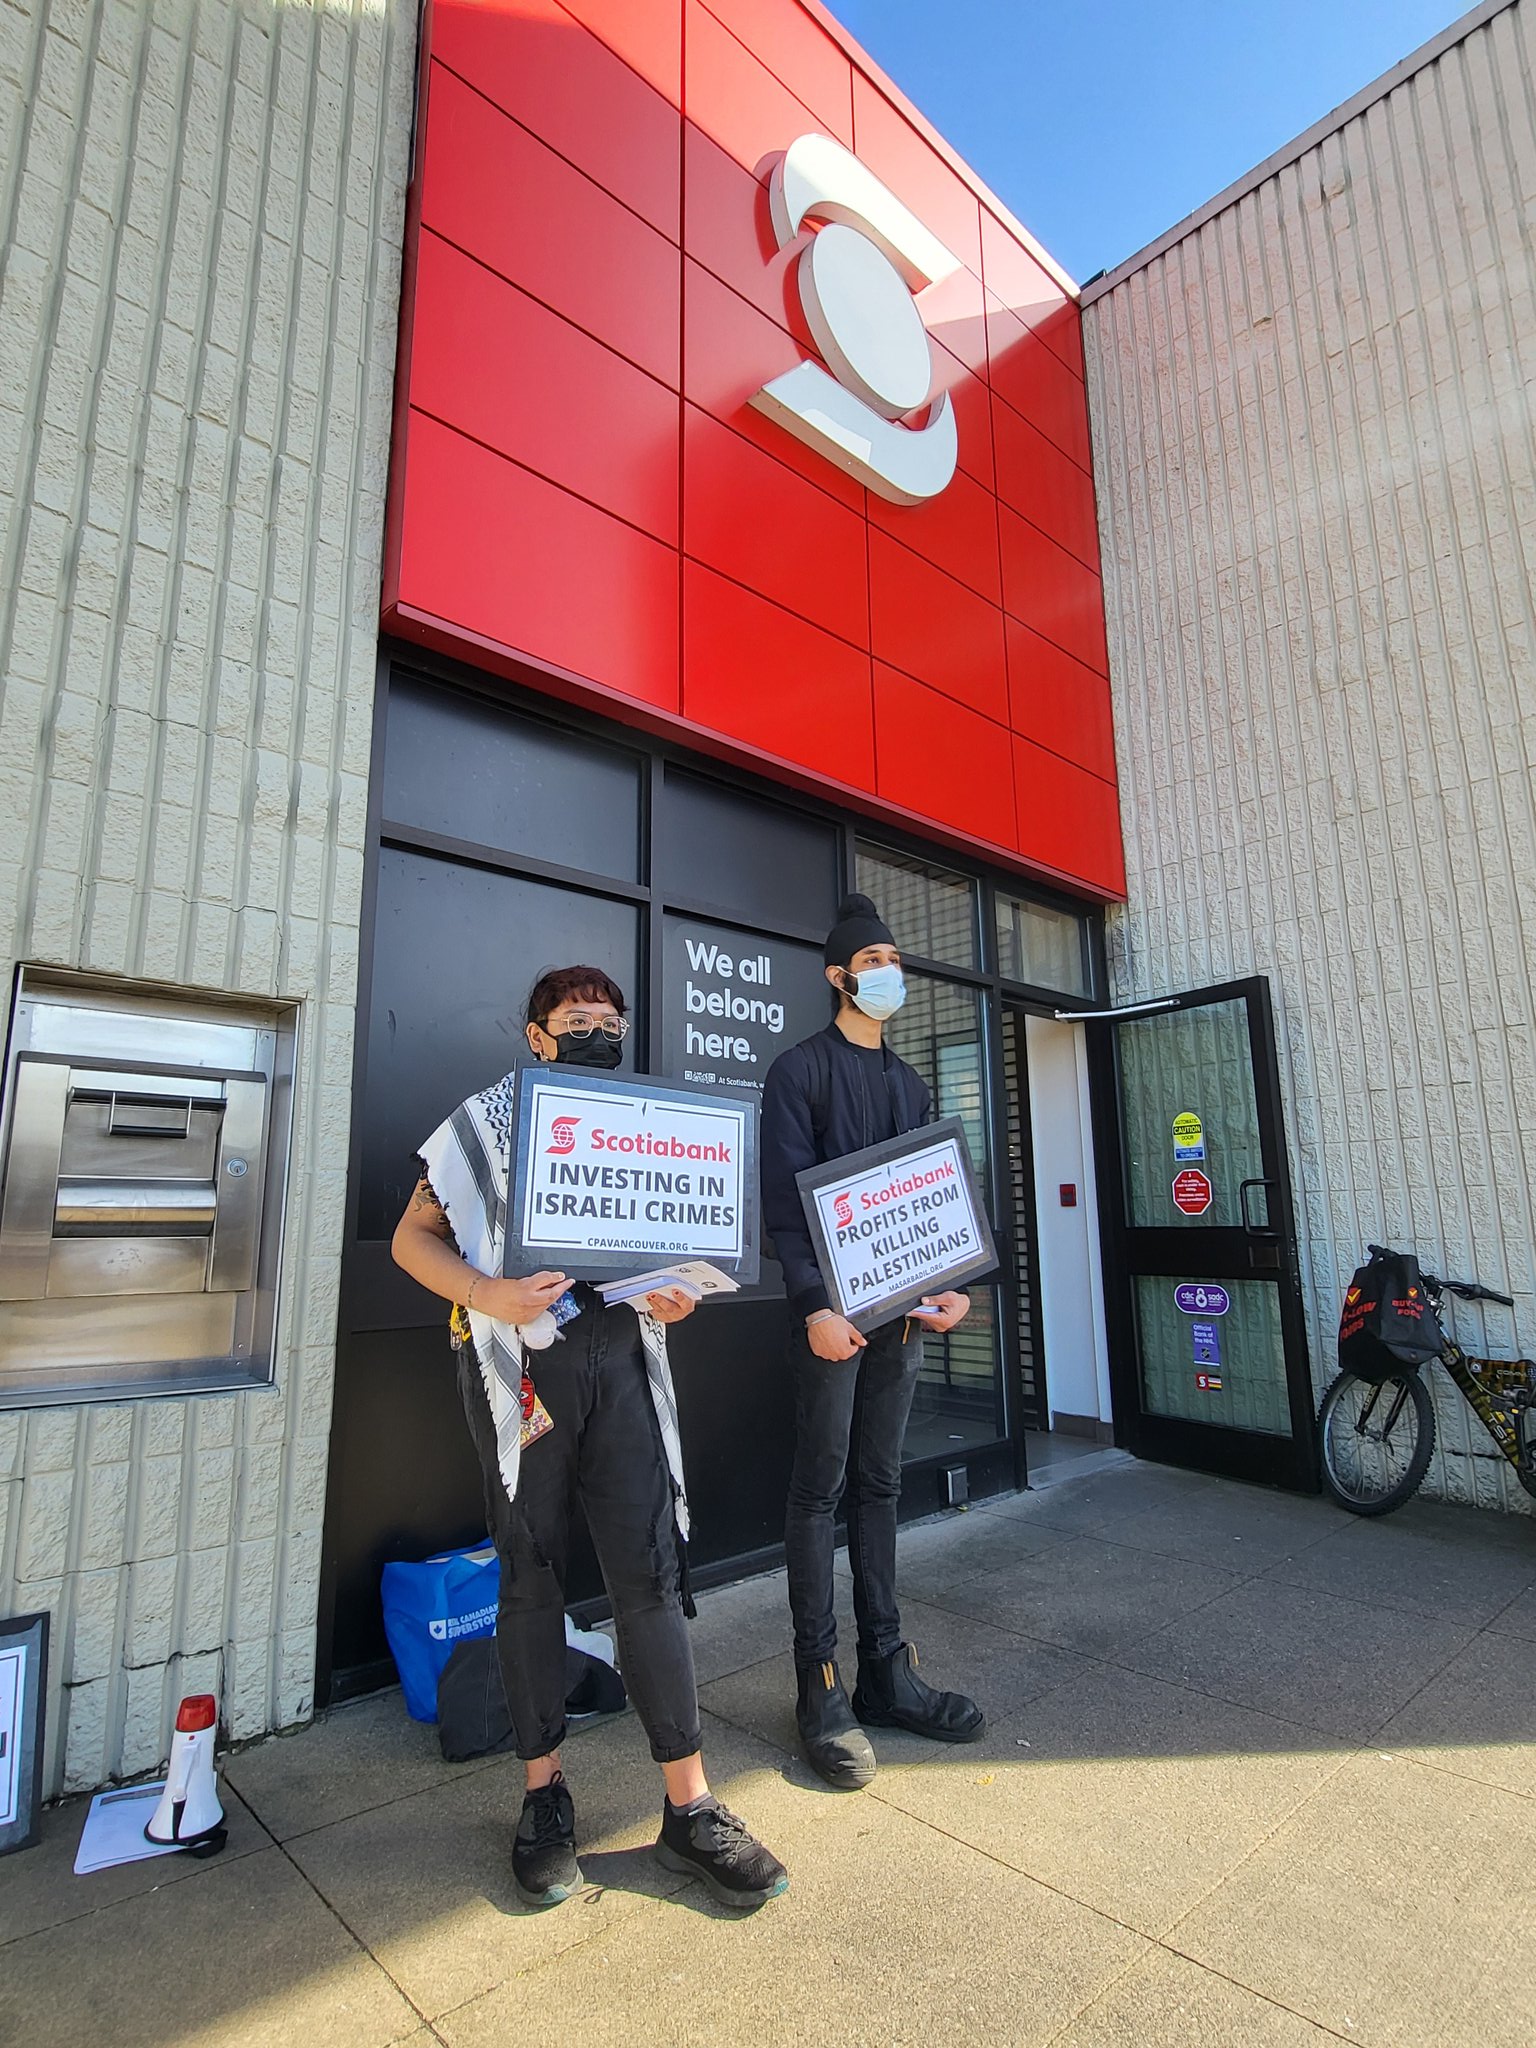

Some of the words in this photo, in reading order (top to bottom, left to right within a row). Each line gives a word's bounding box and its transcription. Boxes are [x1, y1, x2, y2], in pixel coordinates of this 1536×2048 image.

[685, 939, 734, 978] We
[739, 955, 771, 986] all
[686, 980, 785, 1034] belong
[686, 1023, 758, 1063] here.
[718, 1076, 726, 1085] At
[726, 1076, 759, 1089] Scotiabank,
[590, 1128, 732, 1163] Scotiabank
[1174, 1125, 1201, 1135] CAUTION
[549, 1162, 691, 1195] INVESTING
[699, 1176, 725, 1198] IN
[860, 1160, 956, 1211] Scotiabank
[535, 1191, 636, 1220] ISRAELI
[645, 1200, 735, 1227] CRIMES
[835, 1205, 908, 1248] PROFITS
[911, 1183, 960, 1216] FROM
[587, 1237, 689, 1252] CPAVANCOUVER.ORG
[870, 1216, 940, 1259] KILLING
[848, 1227, 970, 1296] PALESTINIANS
[459, 1602, 499, 1624] CANADIAN
